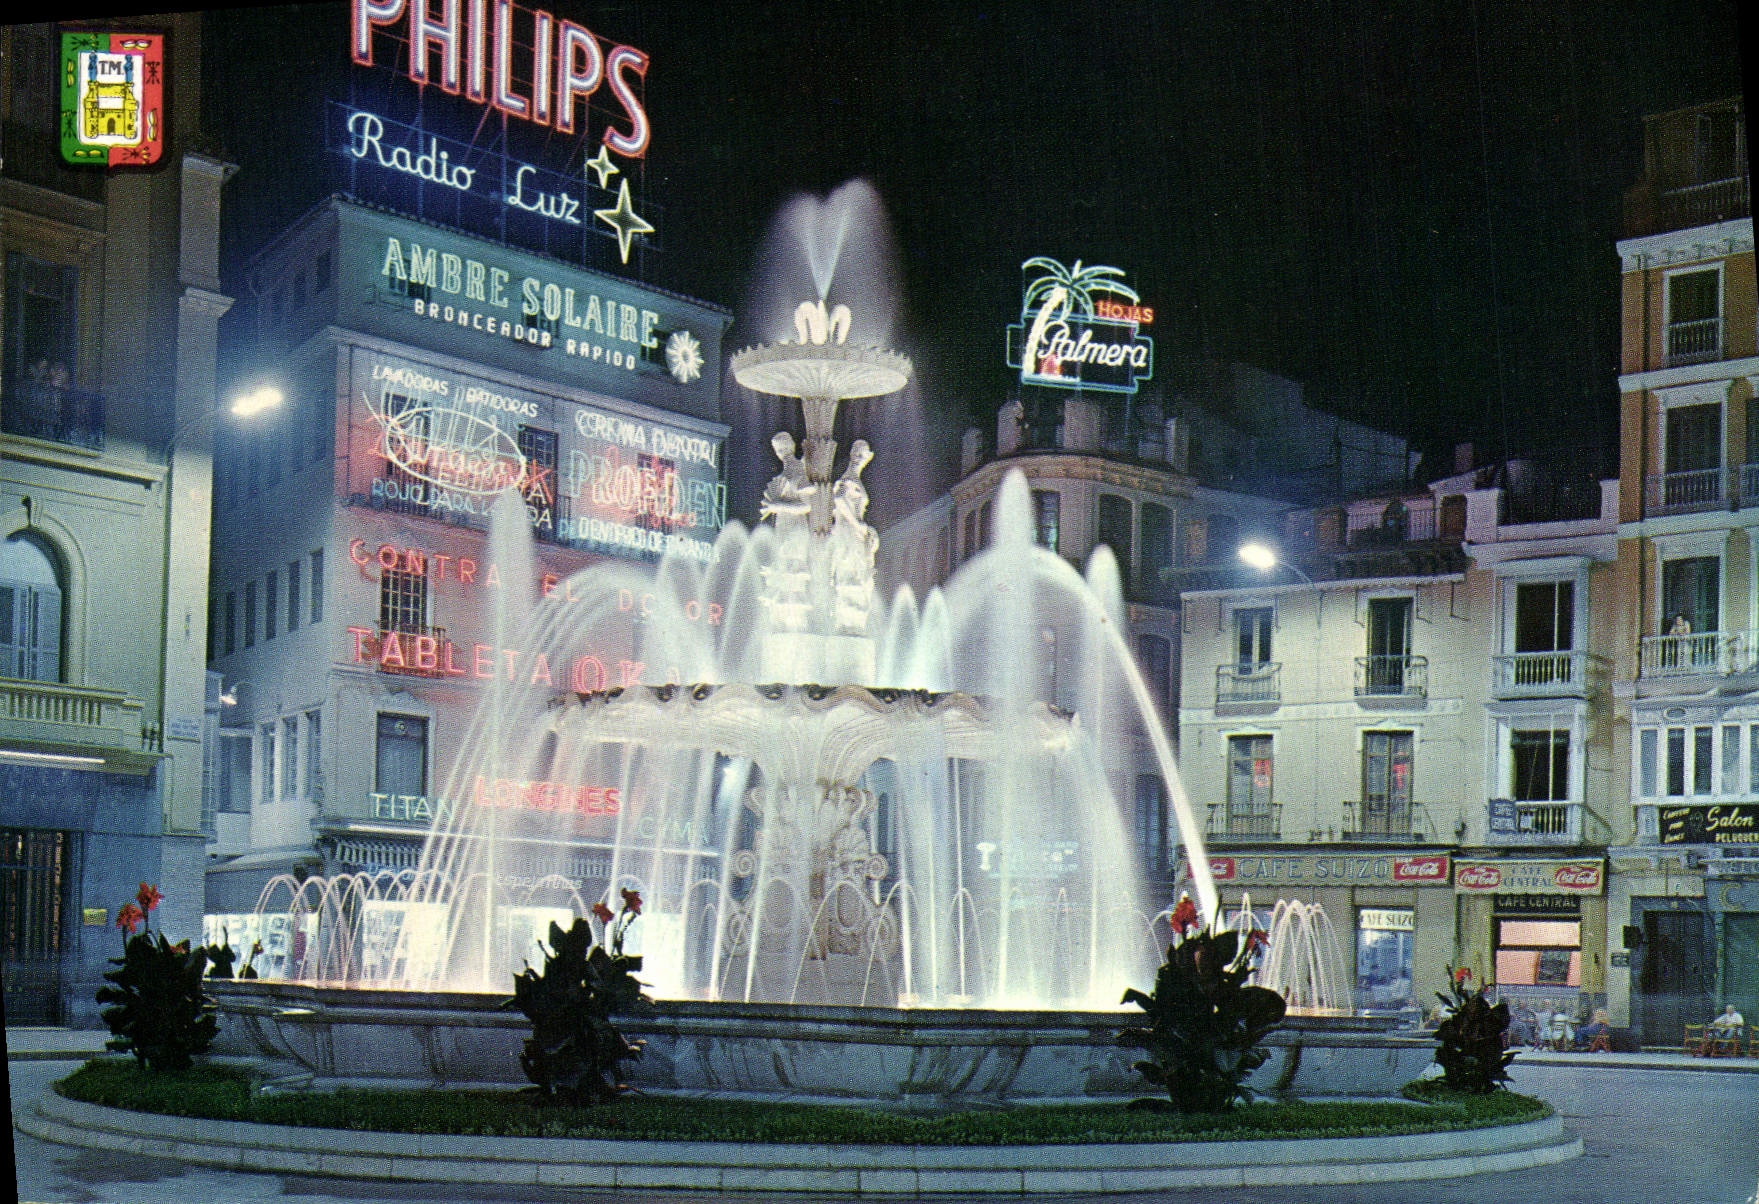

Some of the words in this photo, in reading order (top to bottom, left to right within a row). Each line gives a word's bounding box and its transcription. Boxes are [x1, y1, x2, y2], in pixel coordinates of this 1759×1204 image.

[351, 0, 650, 159] PHILIPS
[348, 112, 476, 190] Radio
[508, 165, 581, 224] Luz
[382, 237, 509, 308] AMBRE
[522, 277, 659, 349] SOLAIRE
[1096, 301, 1154, 323] HOJAS
[413, 299, 551, 348] BRONCEADOR
[566, 338, 636, 370] RAPIDO
[1037, 320, 1148, 367] Palmera
[350, 538, 501, 588] CONTRA
[542, 573, 580, 602] EL
[618, 588, 724, 625] DOOR
[347, 626, 553, 687] TABLETA
[1706, 806, 1754, 832] Salon
[1314, 858, 1389, 879] SUIZO
